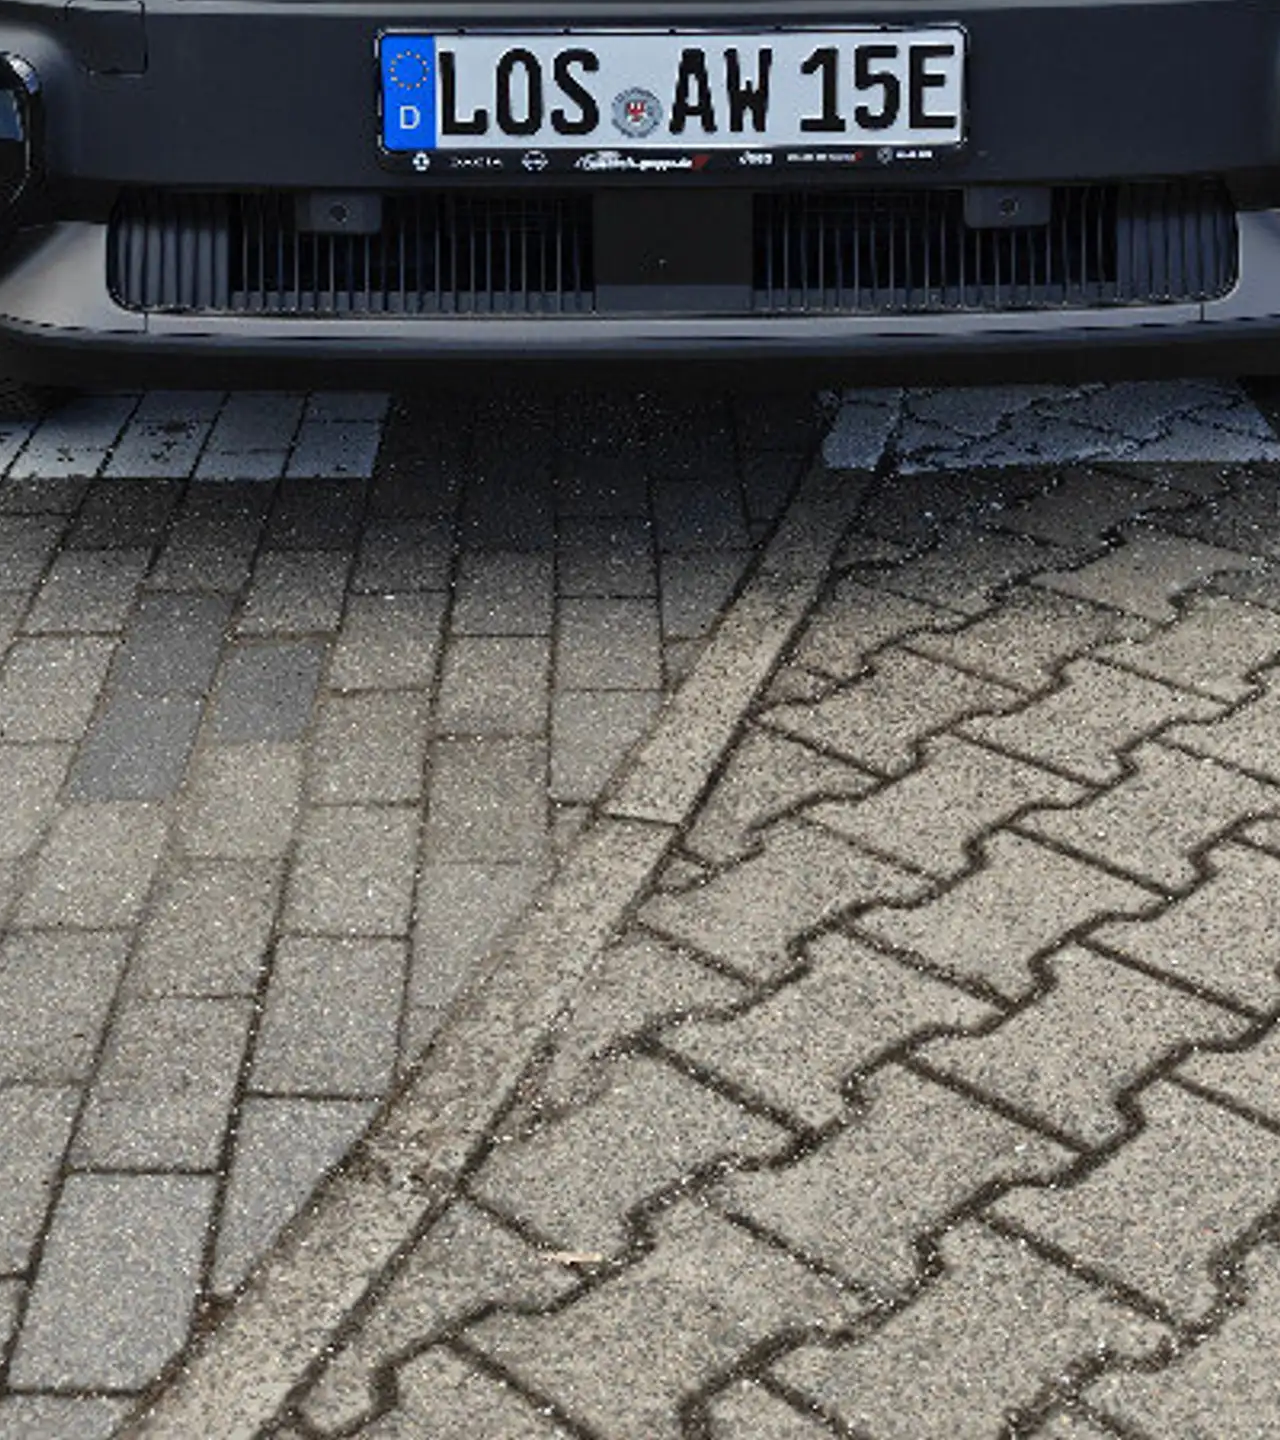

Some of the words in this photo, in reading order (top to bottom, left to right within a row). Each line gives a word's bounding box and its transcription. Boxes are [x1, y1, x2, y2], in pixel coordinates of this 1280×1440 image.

[399, 104, 421, 130] D
[438, 48, 600, 137] LOS
[668, 47, 773, 136] AW
[799, 44, 957, 133] 15E
